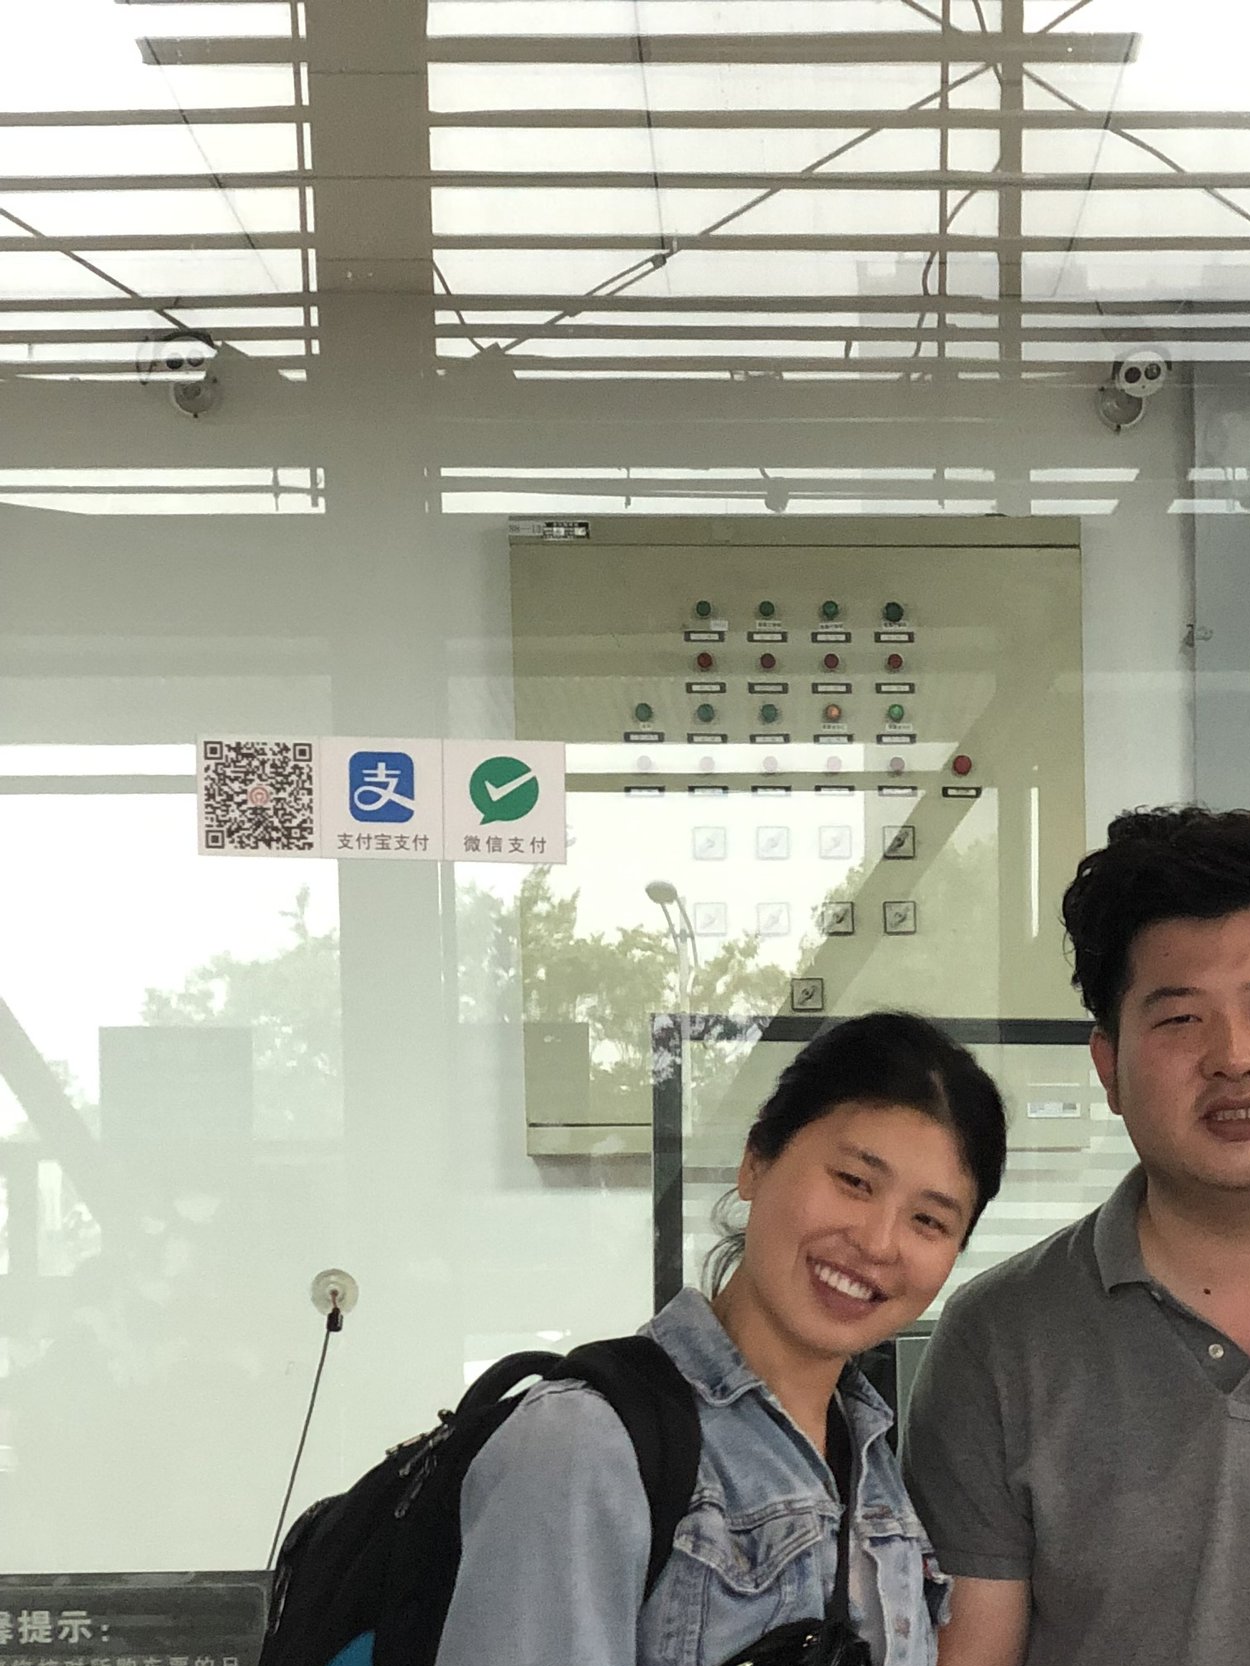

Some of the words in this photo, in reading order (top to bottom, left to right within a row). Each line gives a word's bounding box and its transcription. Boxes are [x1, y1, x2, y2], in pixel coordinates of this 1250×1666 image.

[337, 833, 430, 853] 支付宝支付
[463, 835, 547, 854] 微信支付
